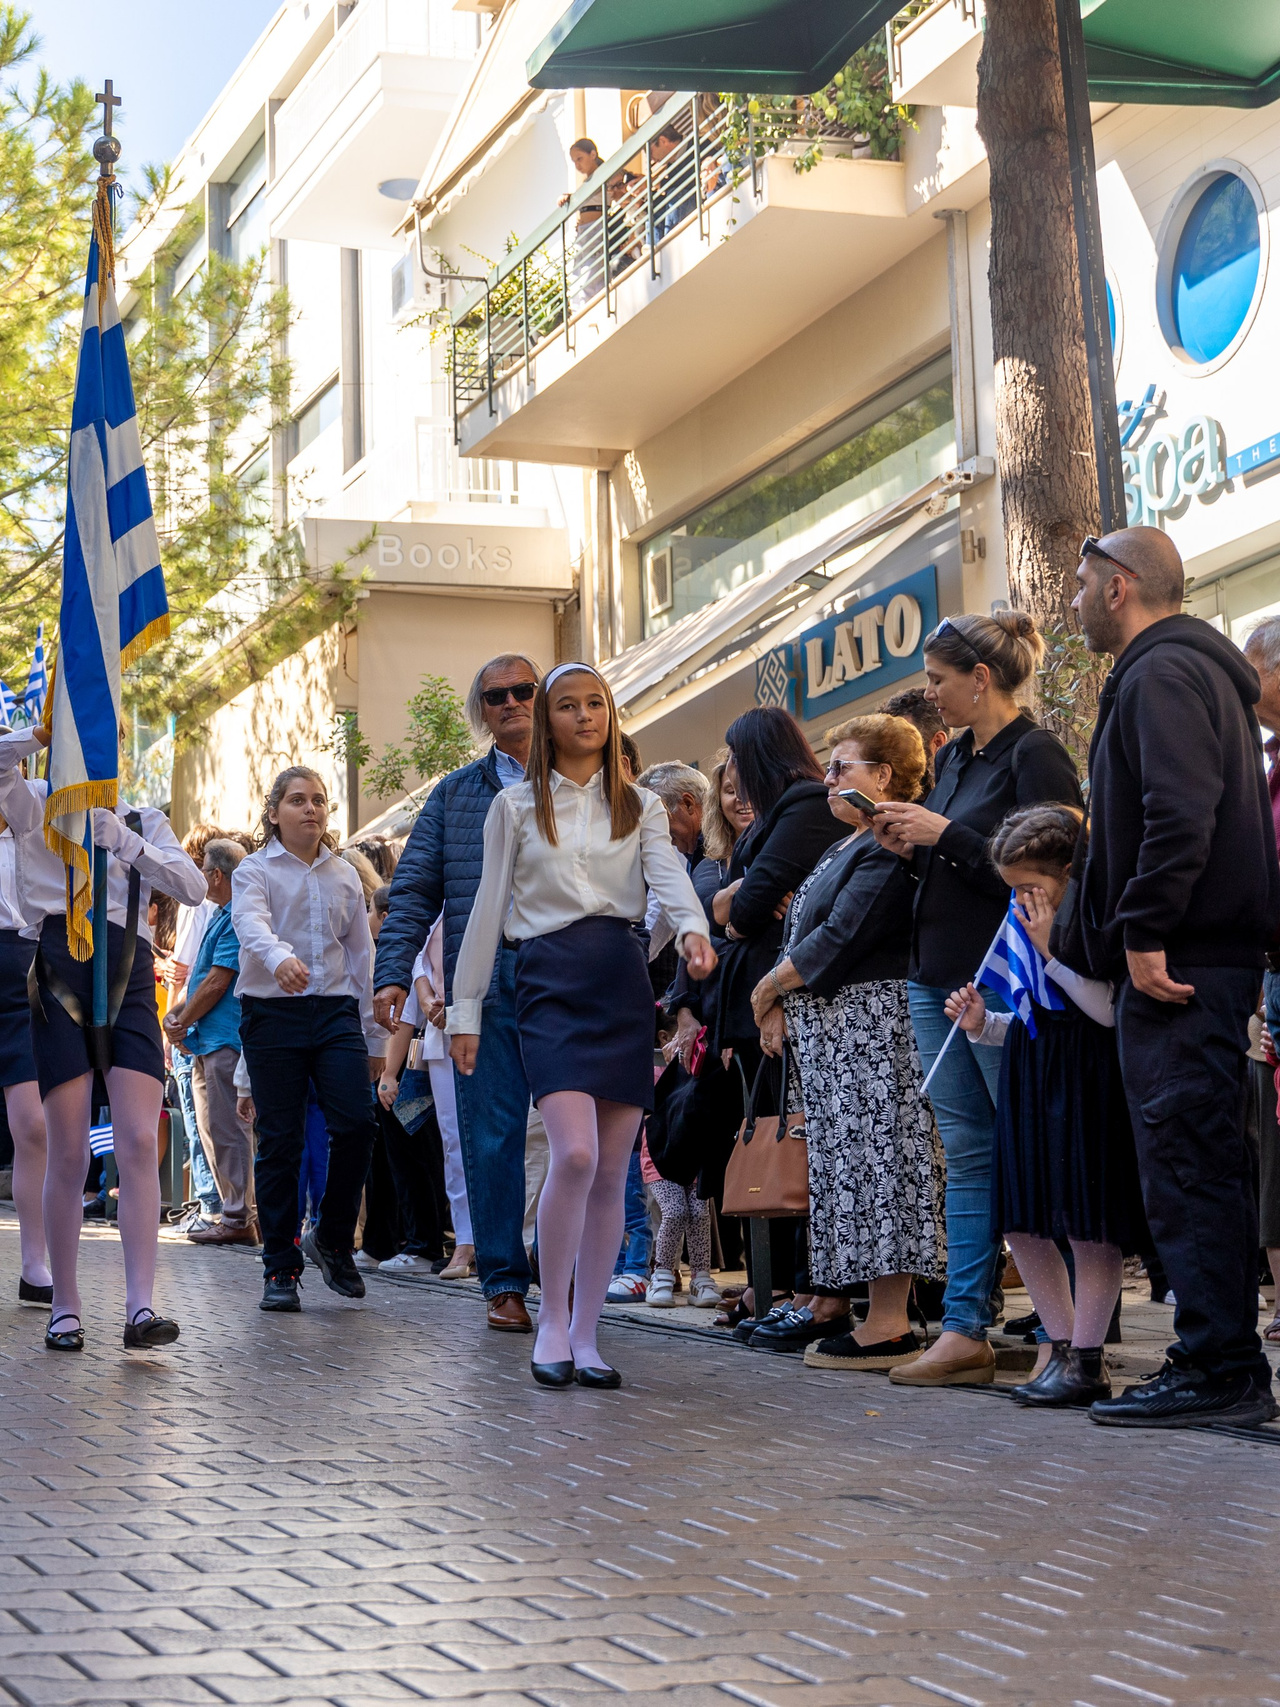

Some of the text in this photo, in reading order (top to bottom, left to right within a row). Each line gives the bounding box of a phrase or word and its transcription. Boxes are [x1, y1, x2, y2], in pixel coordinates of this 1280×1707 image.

[1235, 438, 1277, 470] THE
[378, 533, 512, 572] Books
[805, 593, 922, 699] LATO
